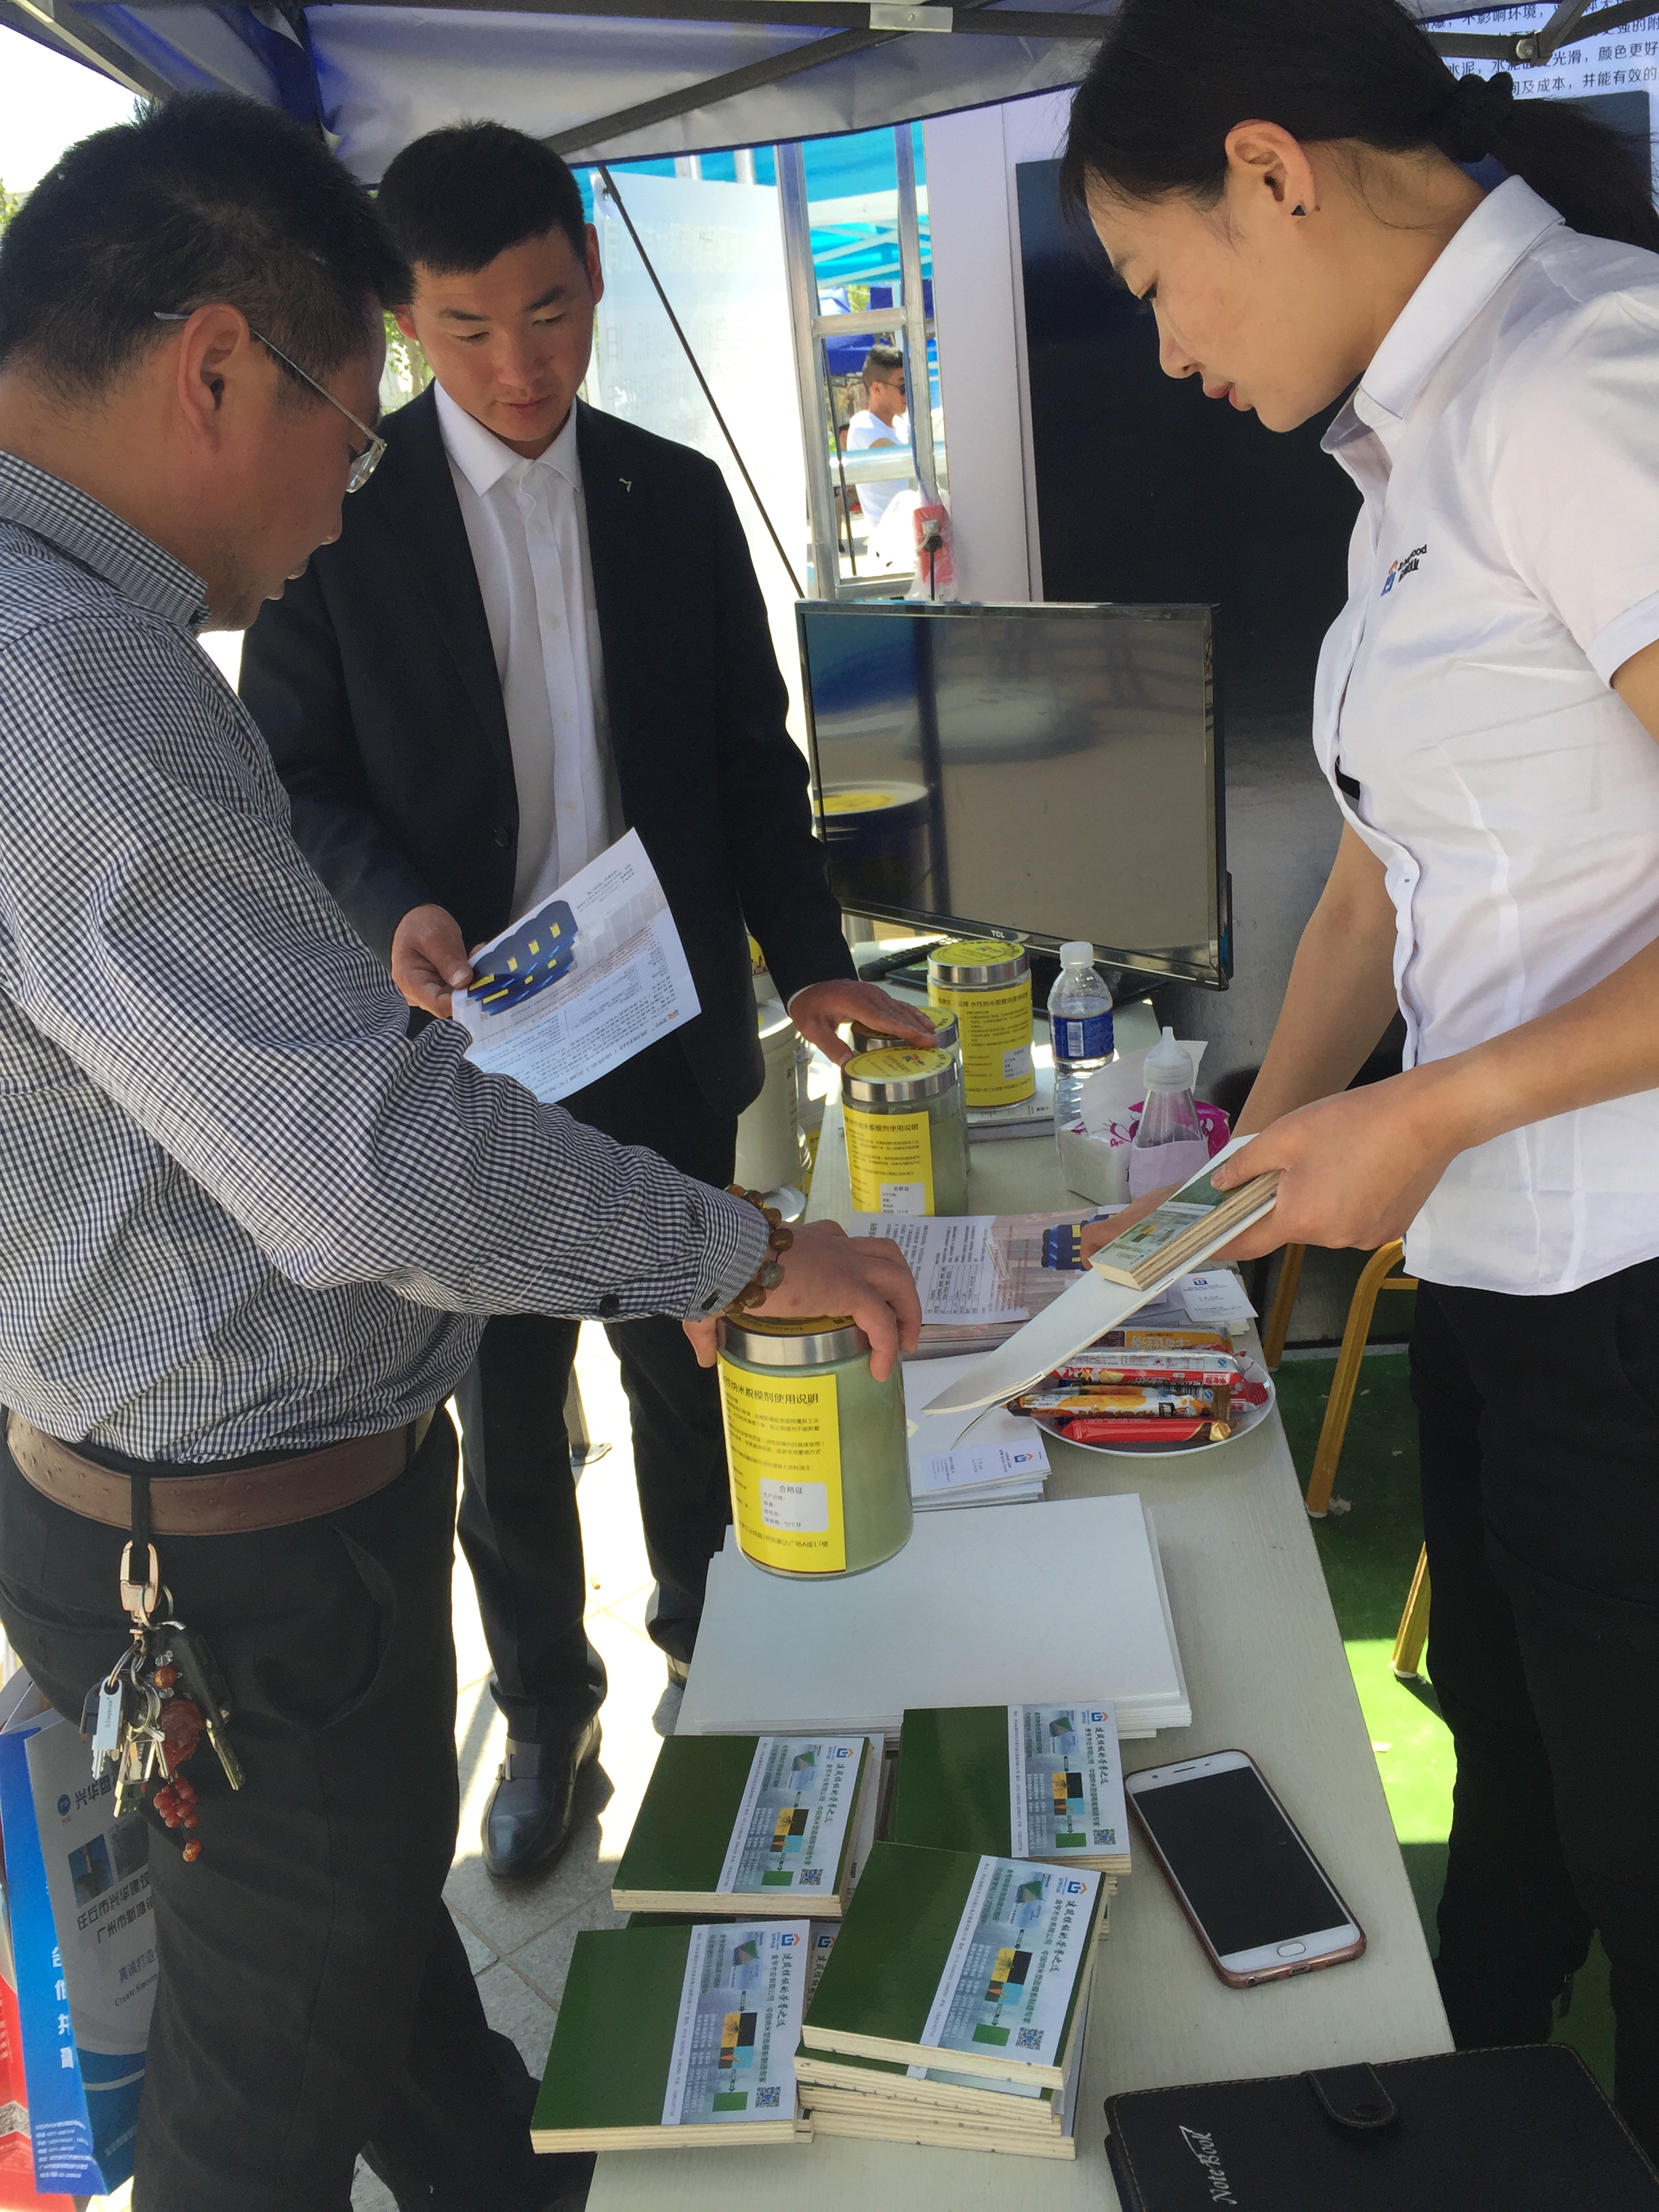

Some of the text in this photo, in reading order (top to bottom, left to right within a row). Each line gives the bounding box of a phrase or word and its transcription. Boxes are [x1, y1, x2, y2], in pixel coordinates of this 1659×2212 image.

[991, 930, 1006, 939] TCL
[723, 1376, 819, 1404] 性纳米脱模剂使用说明
[779, 1484, 803, 1494] 合格证
